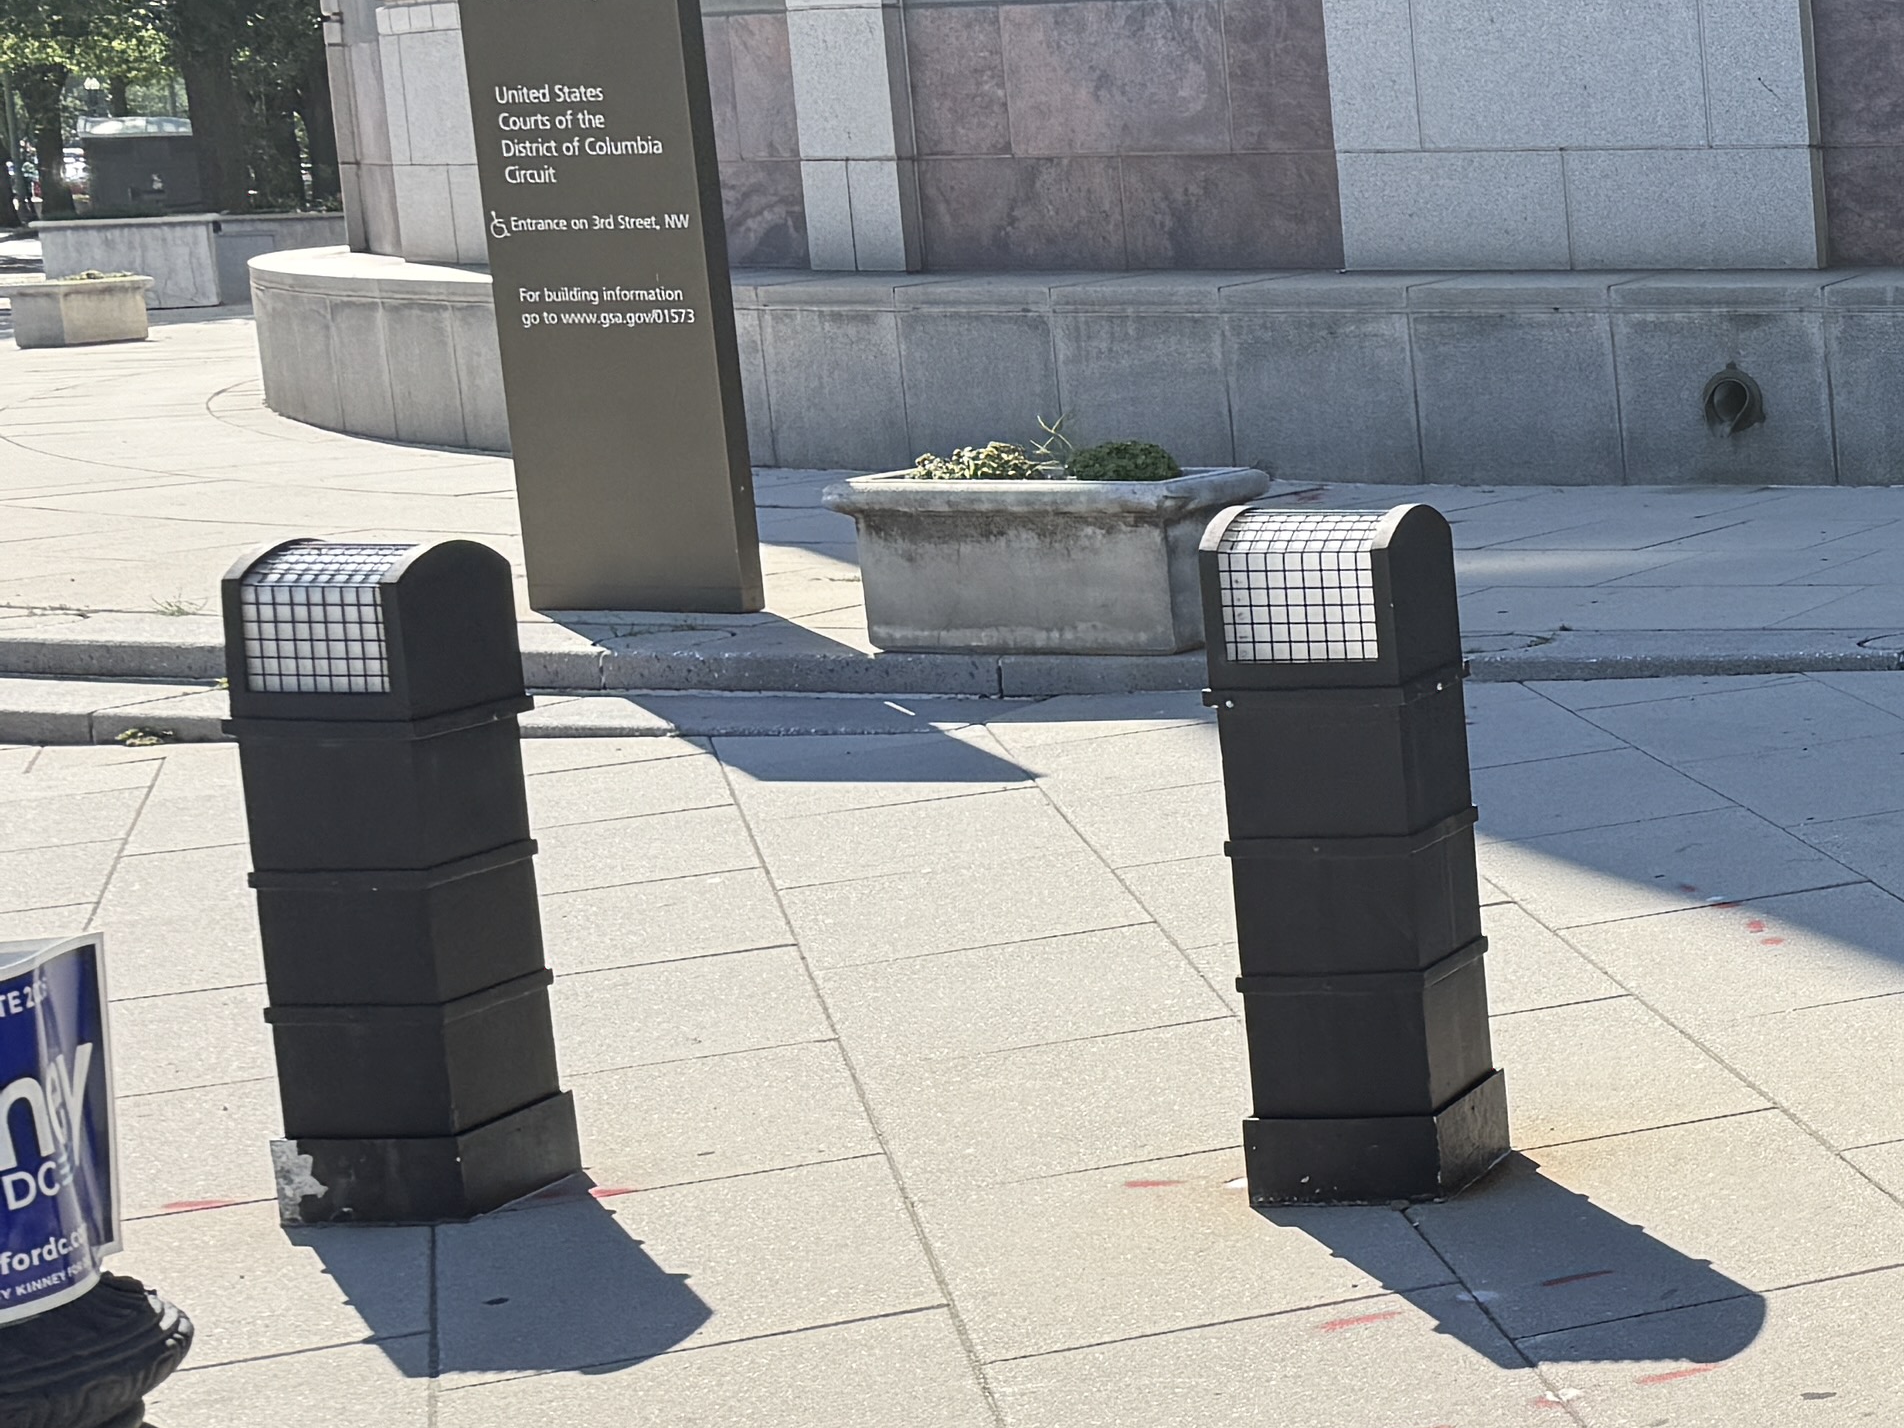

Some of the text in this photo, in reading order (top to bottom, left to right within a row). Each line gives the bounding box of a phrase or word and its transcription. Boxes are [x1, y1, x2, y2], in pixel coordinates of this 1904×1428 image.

[495, 84, 604, 104] United States
[499, 110, 605, 130] Courts of the
[501, 136, 663, 157] District of Columbia
[505, 165, 557, 184] Circuit
[510, 213, 690, 231] Entrance on 3rd Street, NW
[519, 286, 684, 305] For building information
[521, 309, 696, 328] go to www.gsa.gov/01573
[15, 1270, 67, 1297] KINNEY
